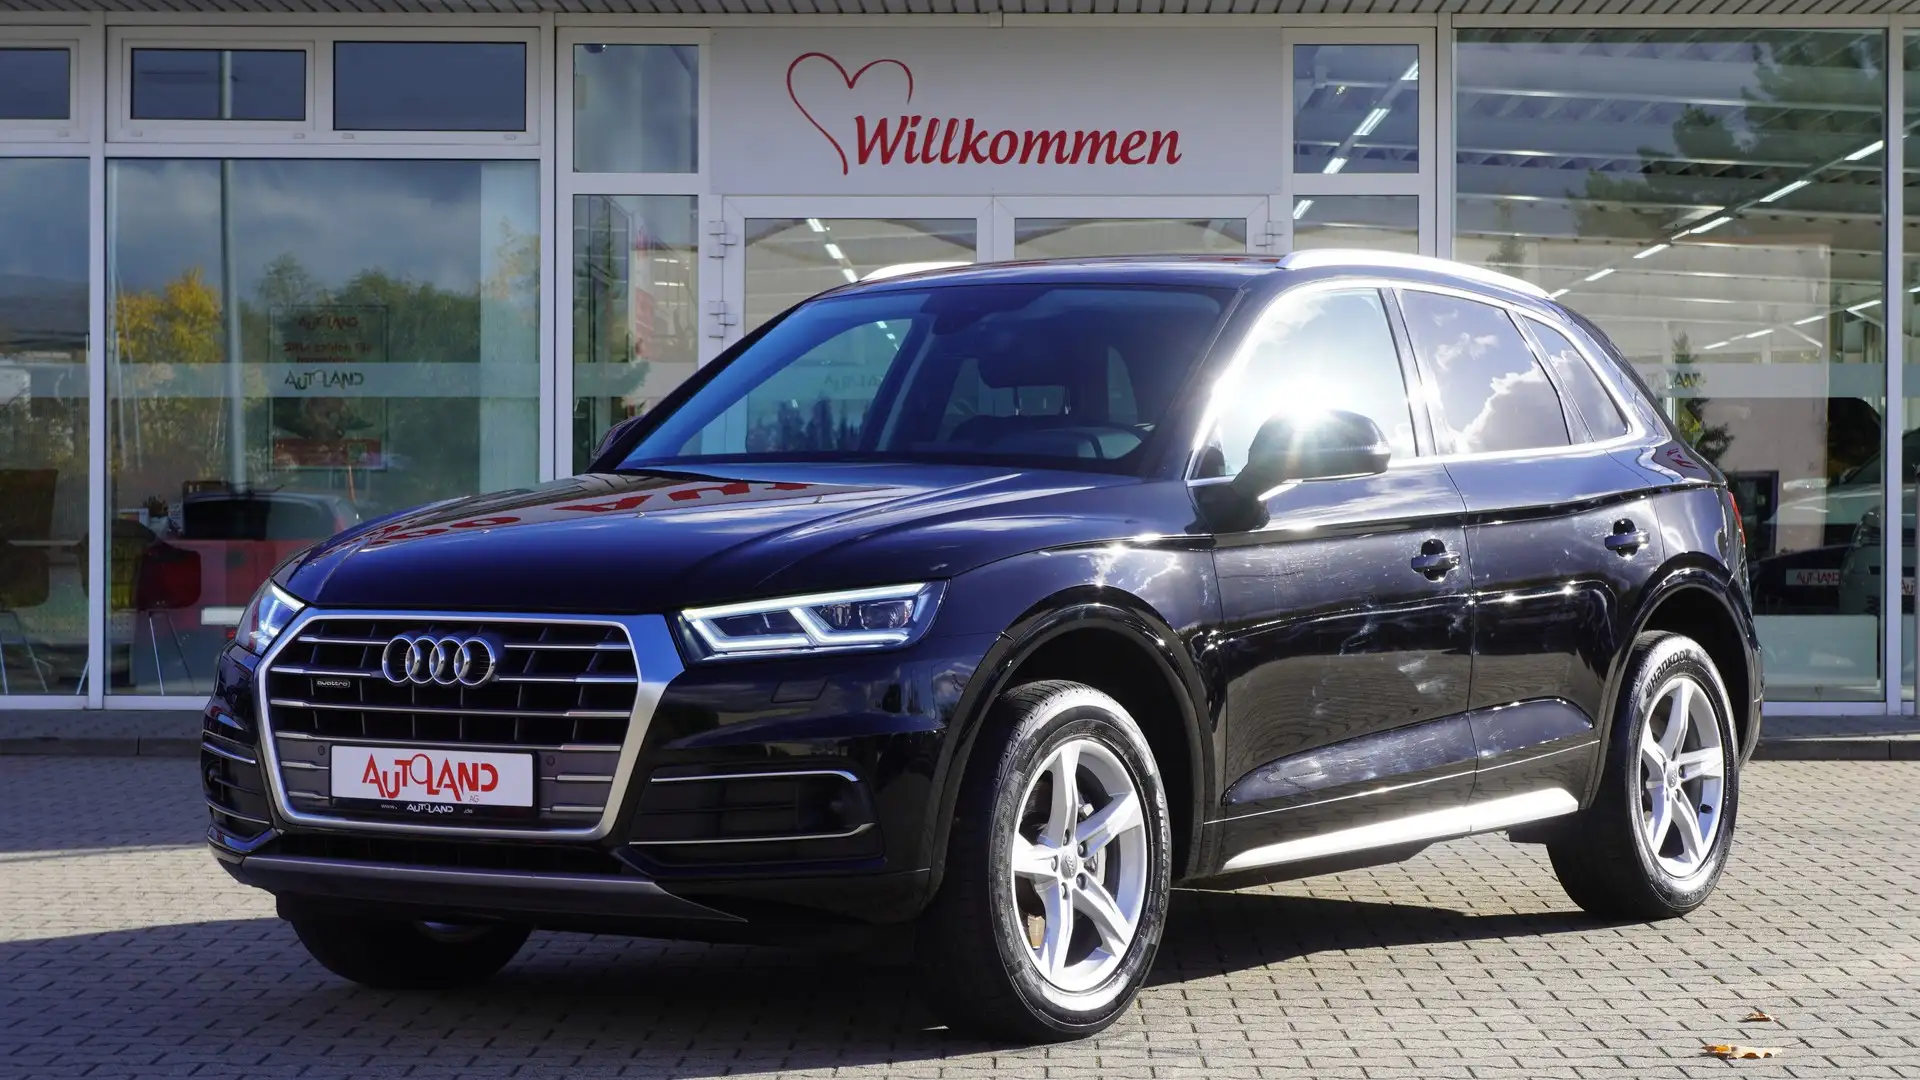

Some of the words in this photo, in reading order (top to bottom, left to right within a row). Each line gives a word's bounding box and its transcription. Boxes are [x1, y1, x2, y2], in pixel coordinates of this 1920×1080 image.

[854, 115, 1182, 165] Willkommen
[284, 369, 365, 390] AUTOLAND
[362, 753, 499, 802] AUTOLAND
[406, 803, 454, 814] AUTOLAND
[469, 794, 480, 803] AG
